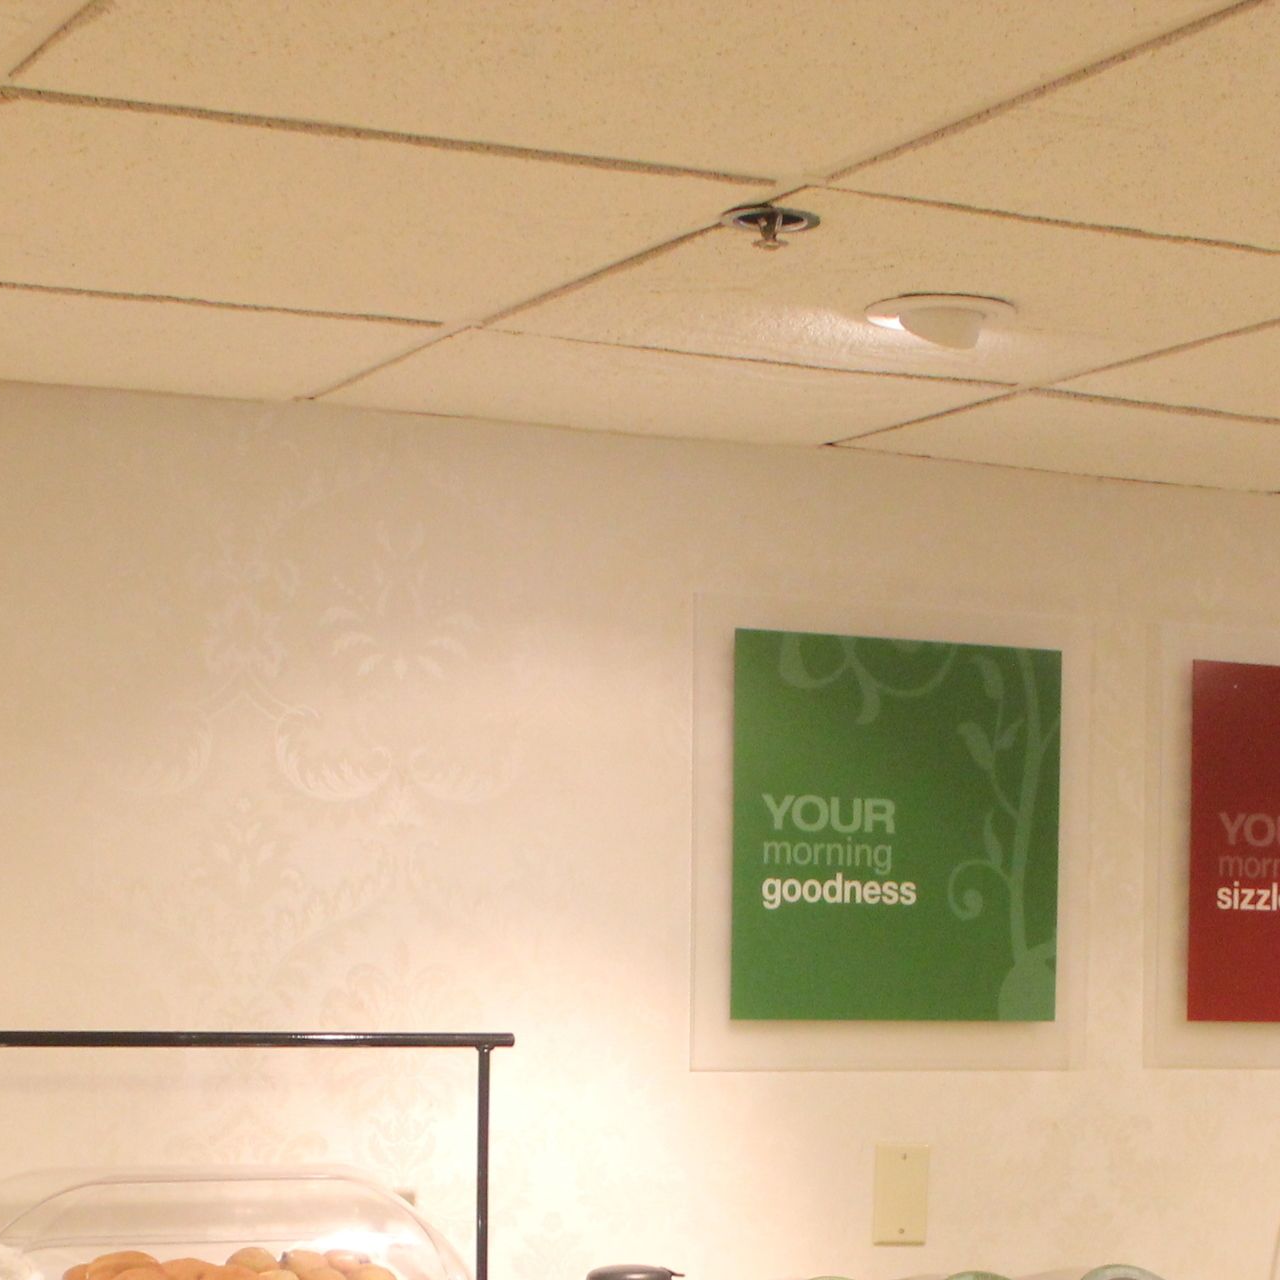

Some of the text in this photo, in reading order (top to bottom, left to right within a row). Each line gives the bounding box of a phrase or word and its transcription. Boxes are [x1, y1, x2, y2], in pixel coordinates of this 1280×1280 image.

[761, 793, 896, 834] YOUR
[763, 836, 893, 876] morning
[761, 872, 918, 910] goodness
